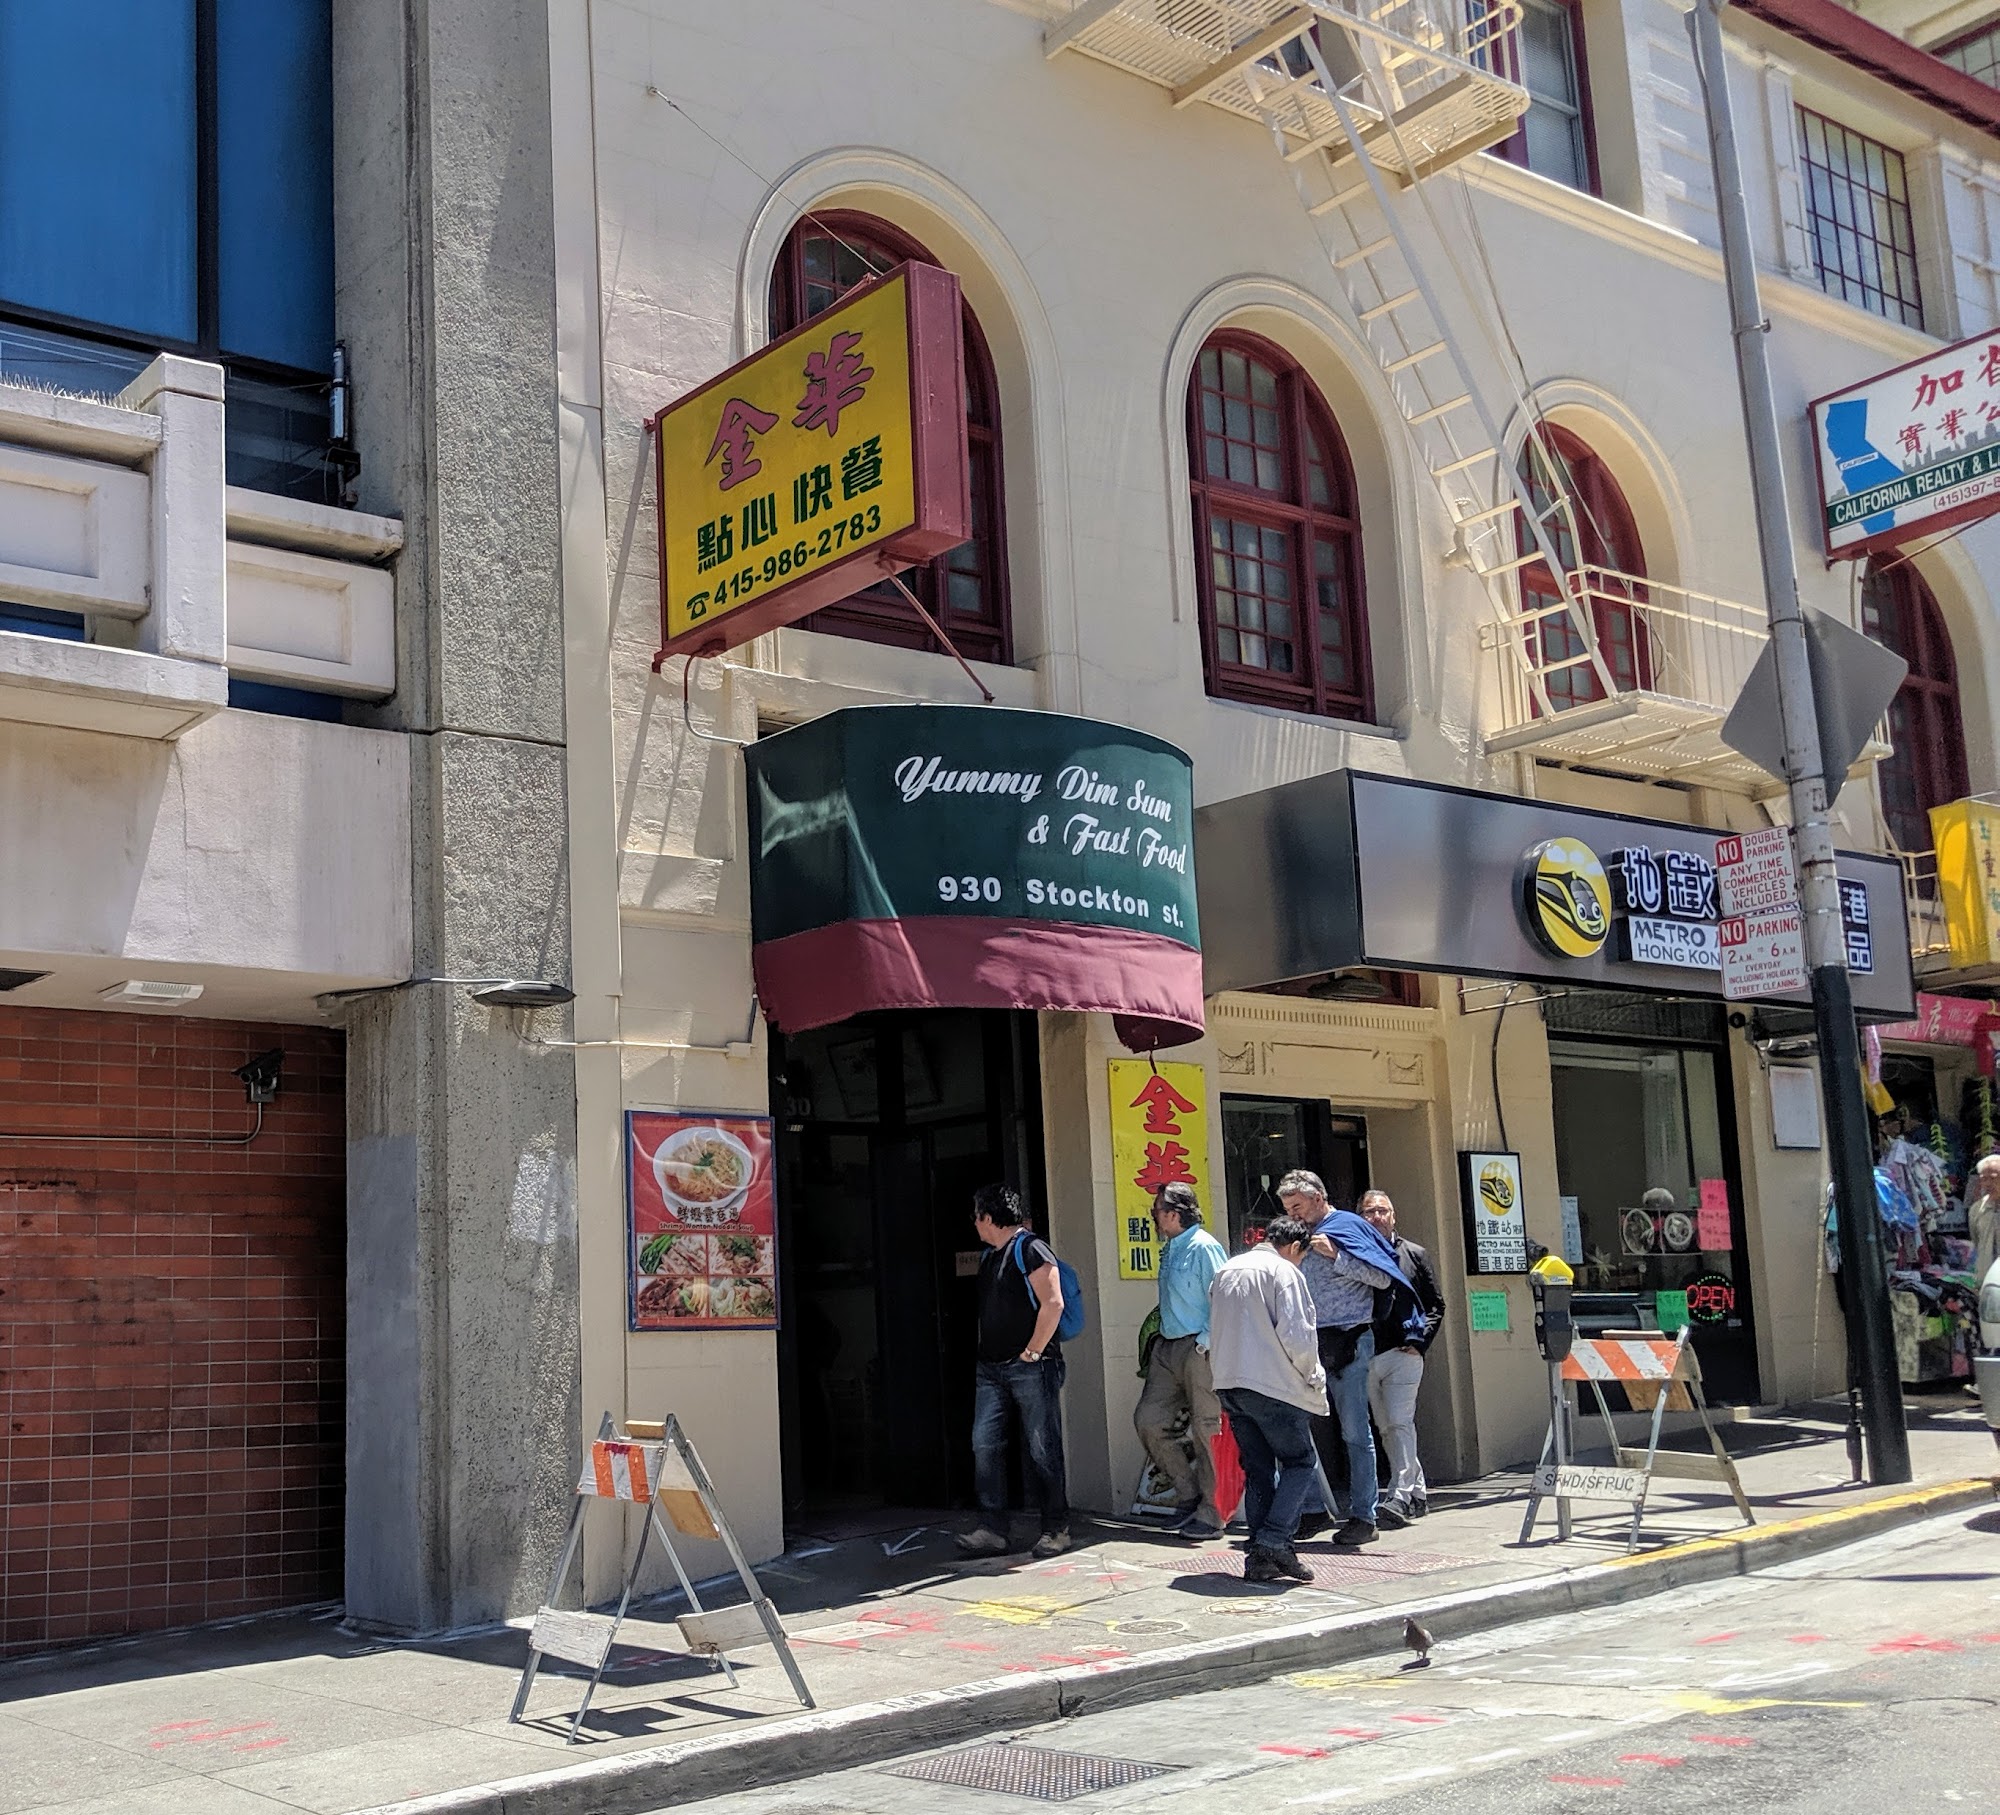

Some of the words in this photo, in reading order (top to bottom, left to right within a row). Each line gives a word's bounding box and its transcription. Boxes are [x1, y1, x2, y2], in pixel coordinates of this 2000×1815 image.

[703, 330, 875, 492] 金華
[1835, 482, 1911, 523] CALIFORNIA
[1915, 464, 1966, 495] REALTY
[1973, 455, 1984, 475] &
[697, 435, 883, 575] 點心快餐
[714, 504, 882, 605] 415-986-2783
[895, 756, 1042, 803] Yummy
[1056, 765, 1119, 806] Dim
[1127, 779, 1172, 822] Sum
[1027, 814, 1049, 845] &
[1064, 813, 1131, 855] Fast
[1137, 827, 1187, 875] Food
[1744, 829, 1784, 847] DOUBLE
[1718, 841, 1739, 864] NO
[1746, 841, 1785, 859] PARKING
[1724, 867, 1791, 890] COMMERCIAL
[1730, 863, 1753, 878] ANY
[1757, 856, 1783, 870] TIME
[1732, 880, 1786, 899] VEHICLES
[1732, 890, 1787, 911] INCLUDED
[938, 876, 1002, 902] 930
[1026, 879, 1149, 918] Stockton
[1162, 903, 1184, 928] st.
[1634, 920, 1706, 947] METRO
[1721, 921, 1744, 944] NO
[1748, 917, 1798, 938] PARKING
[1638, 943, 1685, 962] HONG
[1689, 949, 1720, 966] KON
[1728, 949, 1737, 964] 2
[1771, 943, 1780, 957] 6
[1729, 973, 1765, 985] INCLUDING
[1766, 967, 1800, 979] HOLIDAYS
[1745, 961, 1781, 973] EVERYDAY
[1733, 984, 1759, 995] STREET
[1763, 979, 1798, 990] CLEANING
[1129, 1075, 1198, 1195] 金華
[660, 1223, 684, 1232] Shrimp
[686, 1223, 710, 1232] Wonton
[713, 1223, 736, 1232] Noodle
[738, 1223, 754, 1232] Soup
[1686, 1285, 1734, 1309] OPEN
